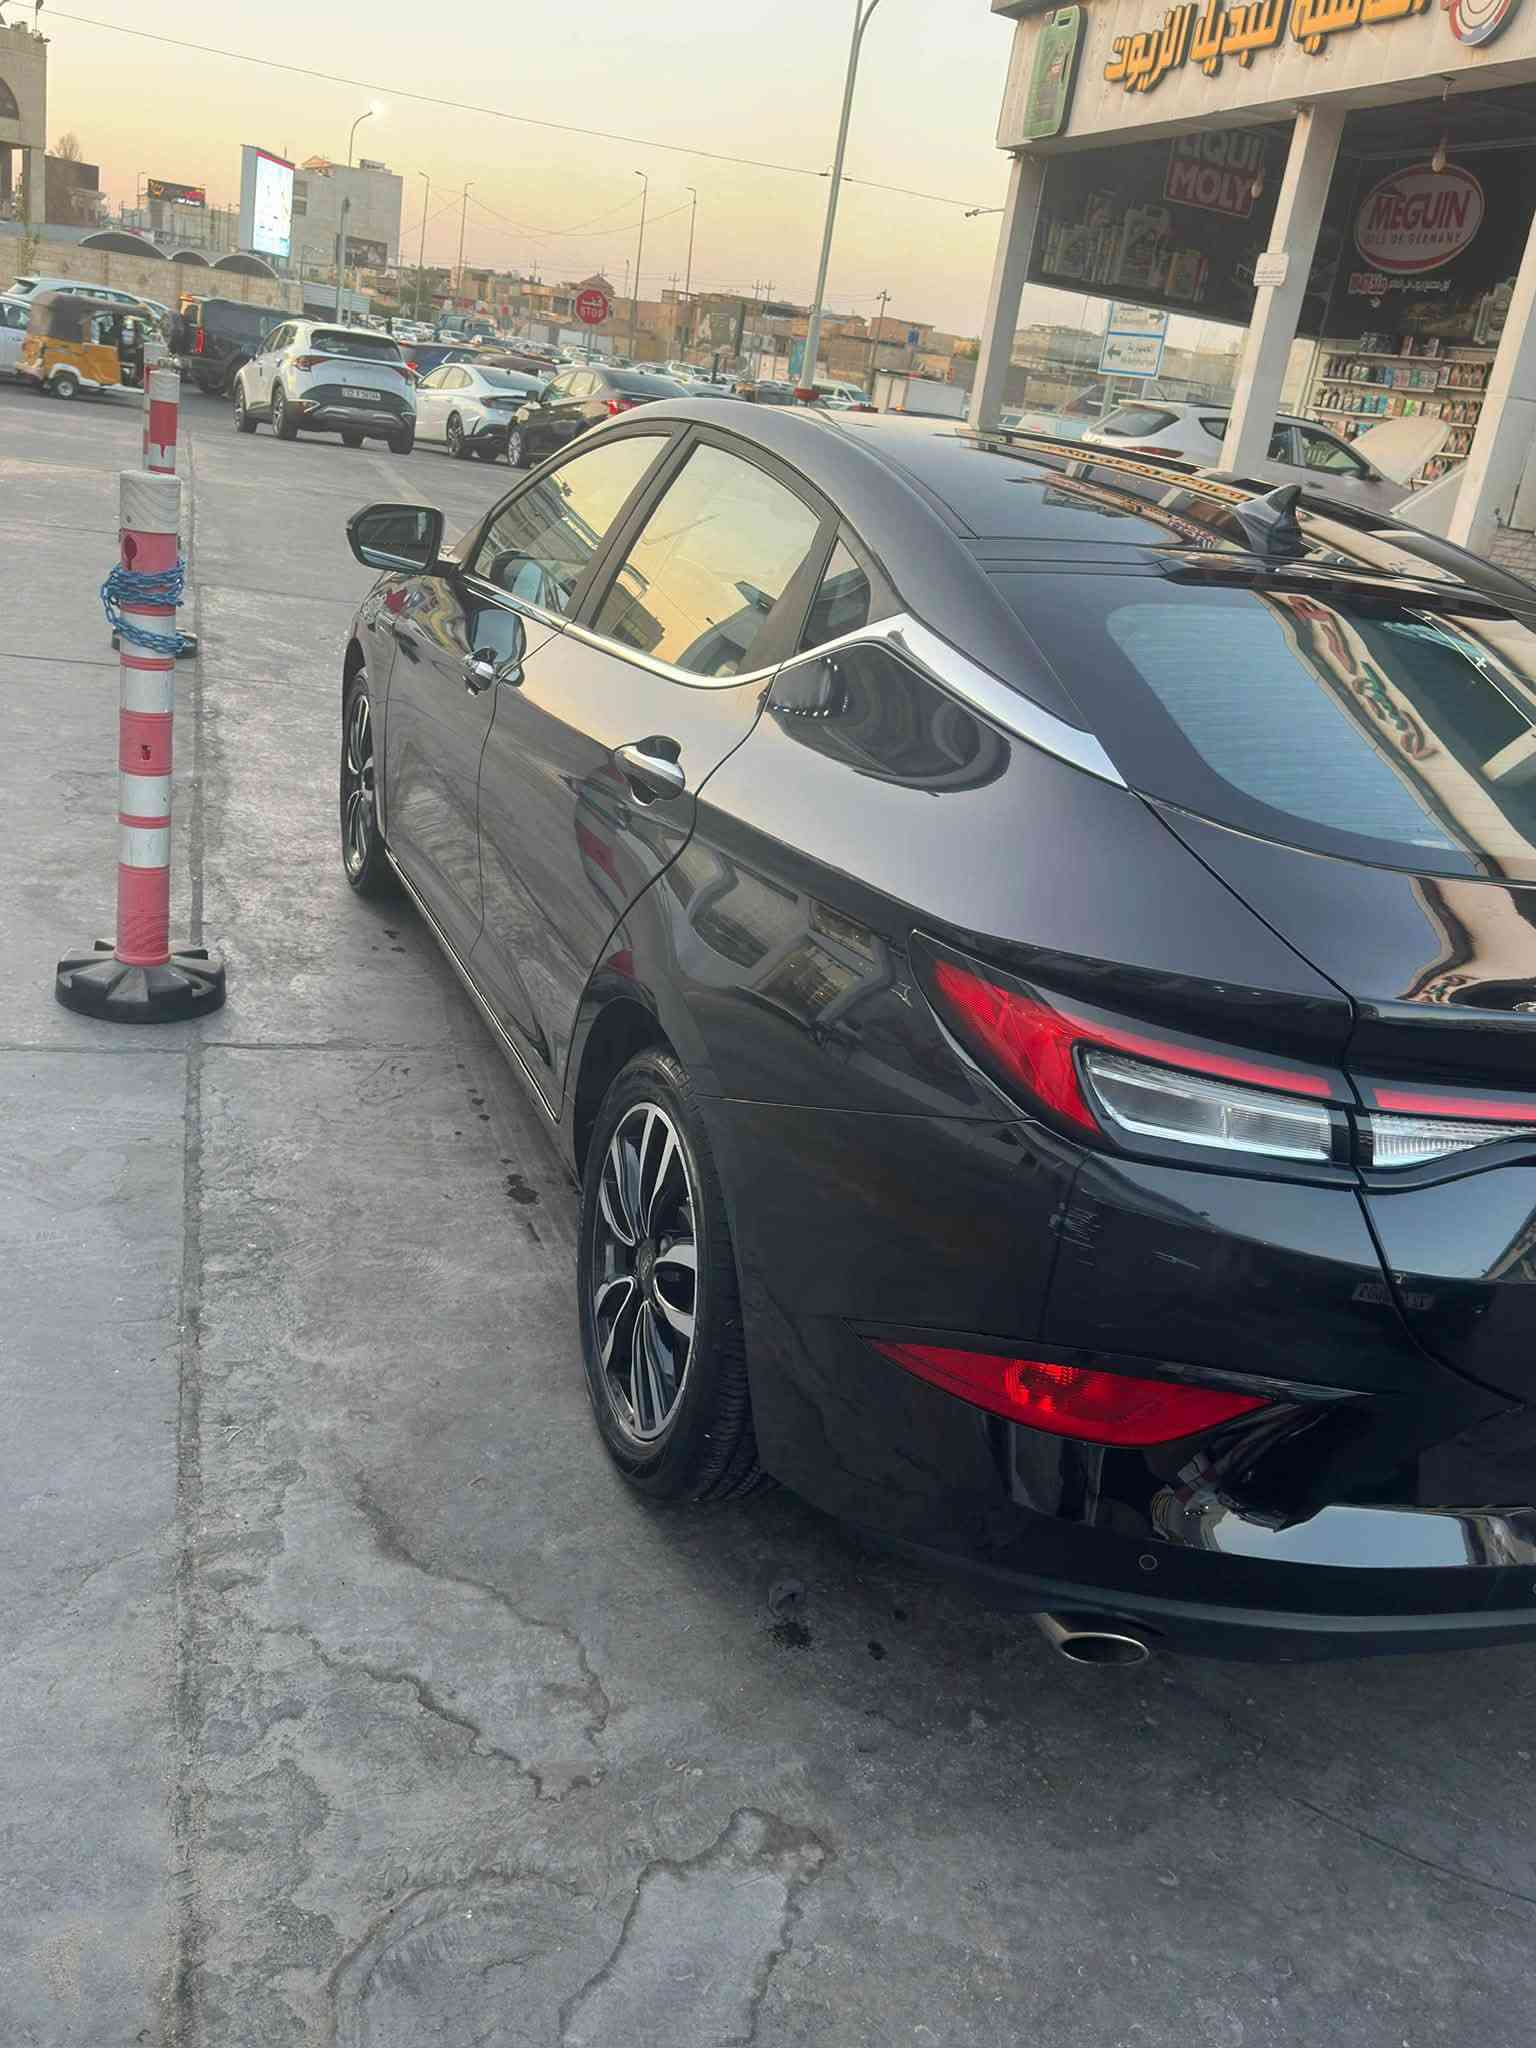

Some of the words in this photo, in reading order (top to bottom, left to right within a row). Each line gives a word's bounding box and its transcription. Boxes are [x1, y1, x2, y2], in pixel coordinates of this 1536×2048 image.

[1104, 4, 1198, 93] الزيوت
[1168, 160, 1251, 211] MOLY
[580, 307, 604, 319] STOP
